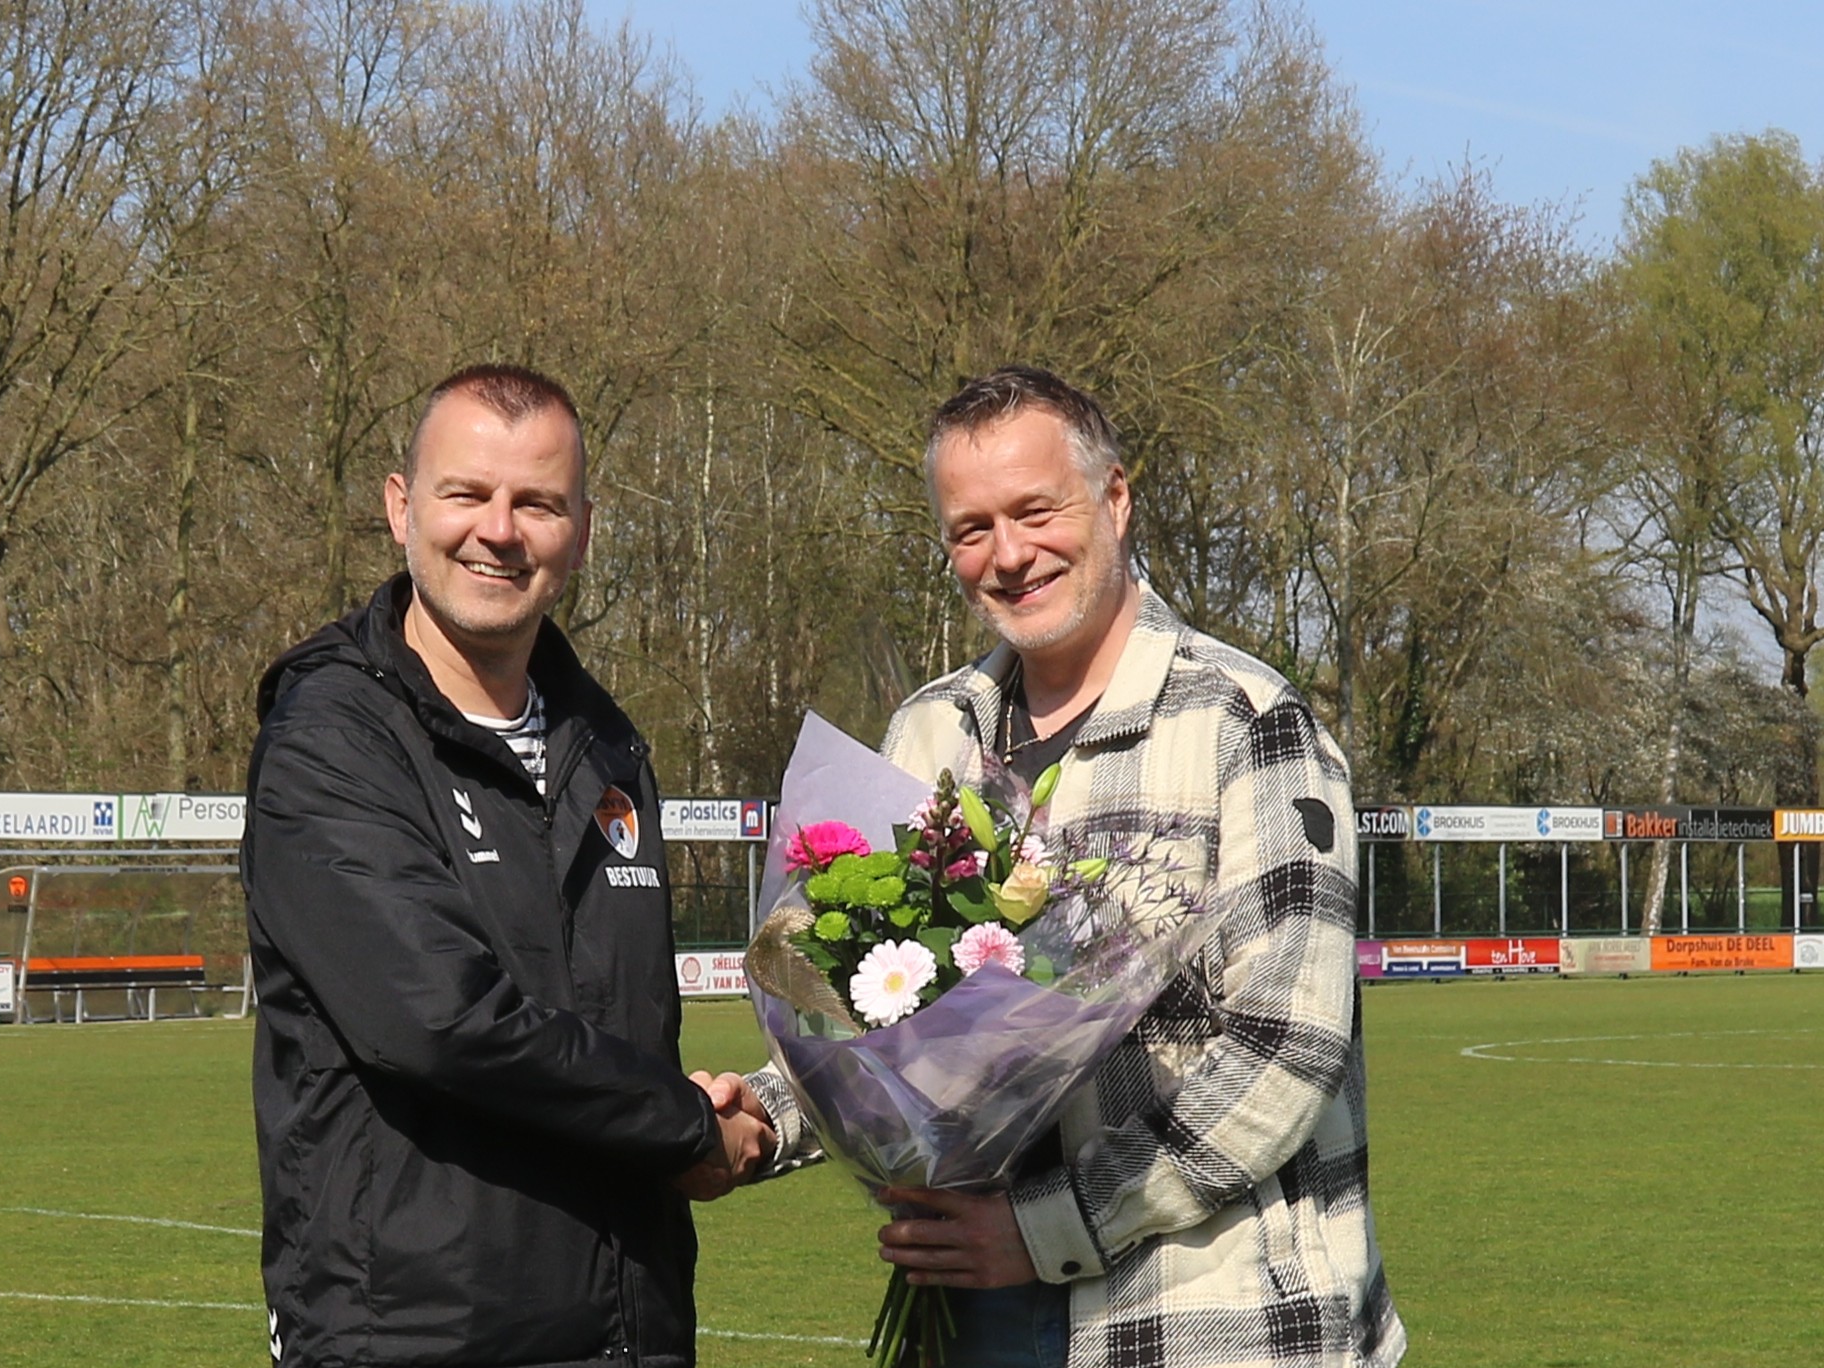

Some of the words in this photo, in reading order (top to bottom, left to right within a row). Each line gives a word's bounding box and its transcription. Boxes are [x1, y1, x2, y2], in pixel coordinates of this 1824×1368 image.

[680, 800, 738, 824] plastics
[1433, 816, 1485, 830] BROEKHUIS
[1552, 815, 1600, 829] BROEKHUIS
[1626, 811, 1678, 838] Bakker
[1678, 814, 1773, 838] installatietechniek
[92, 828, 114, 836] NVM
[604, 866, 661, 888] BESTUUR
[1666, 939, 1722, 955] Dorpshuis
[1727, 939, 1743, 951] DE
[1746, 938, 1775, 951] DEEL
[705, 977, 711, 990] J
[712, 976, 732, 990] VAN
